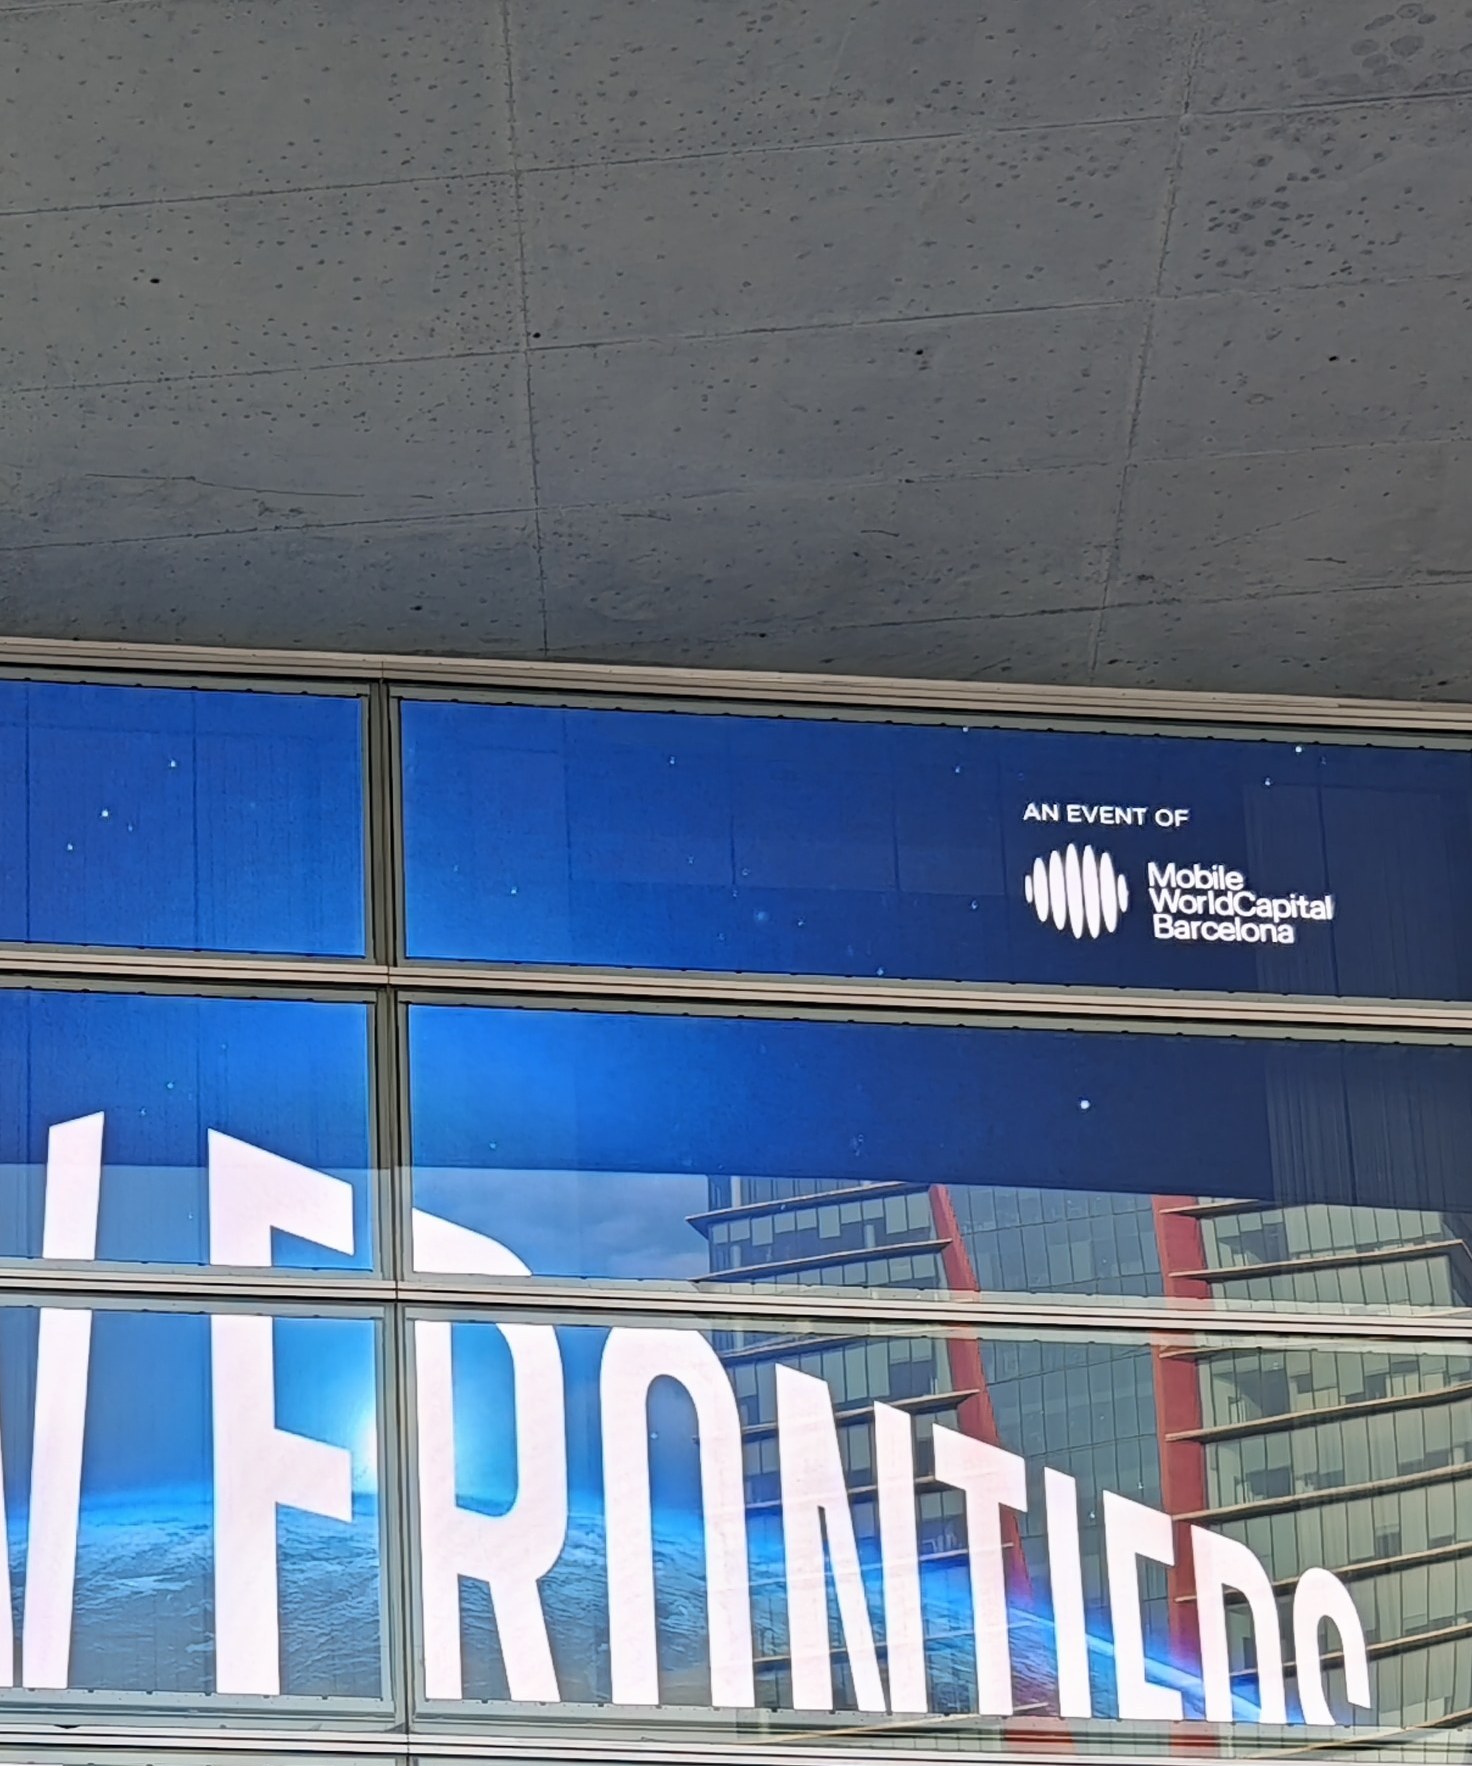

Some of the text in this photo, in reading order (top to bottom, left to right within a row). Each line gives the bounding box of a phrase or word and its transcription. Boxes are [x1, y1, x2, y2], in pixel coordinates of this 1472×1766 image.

[1021, 802, 1189, 827] AN EVENT OF
[1147, 861, 1245, 892] Mobile
[1148, 887, 1334, 921] WorldCapital
[1152, 913, 1296, 944] Barcelona
